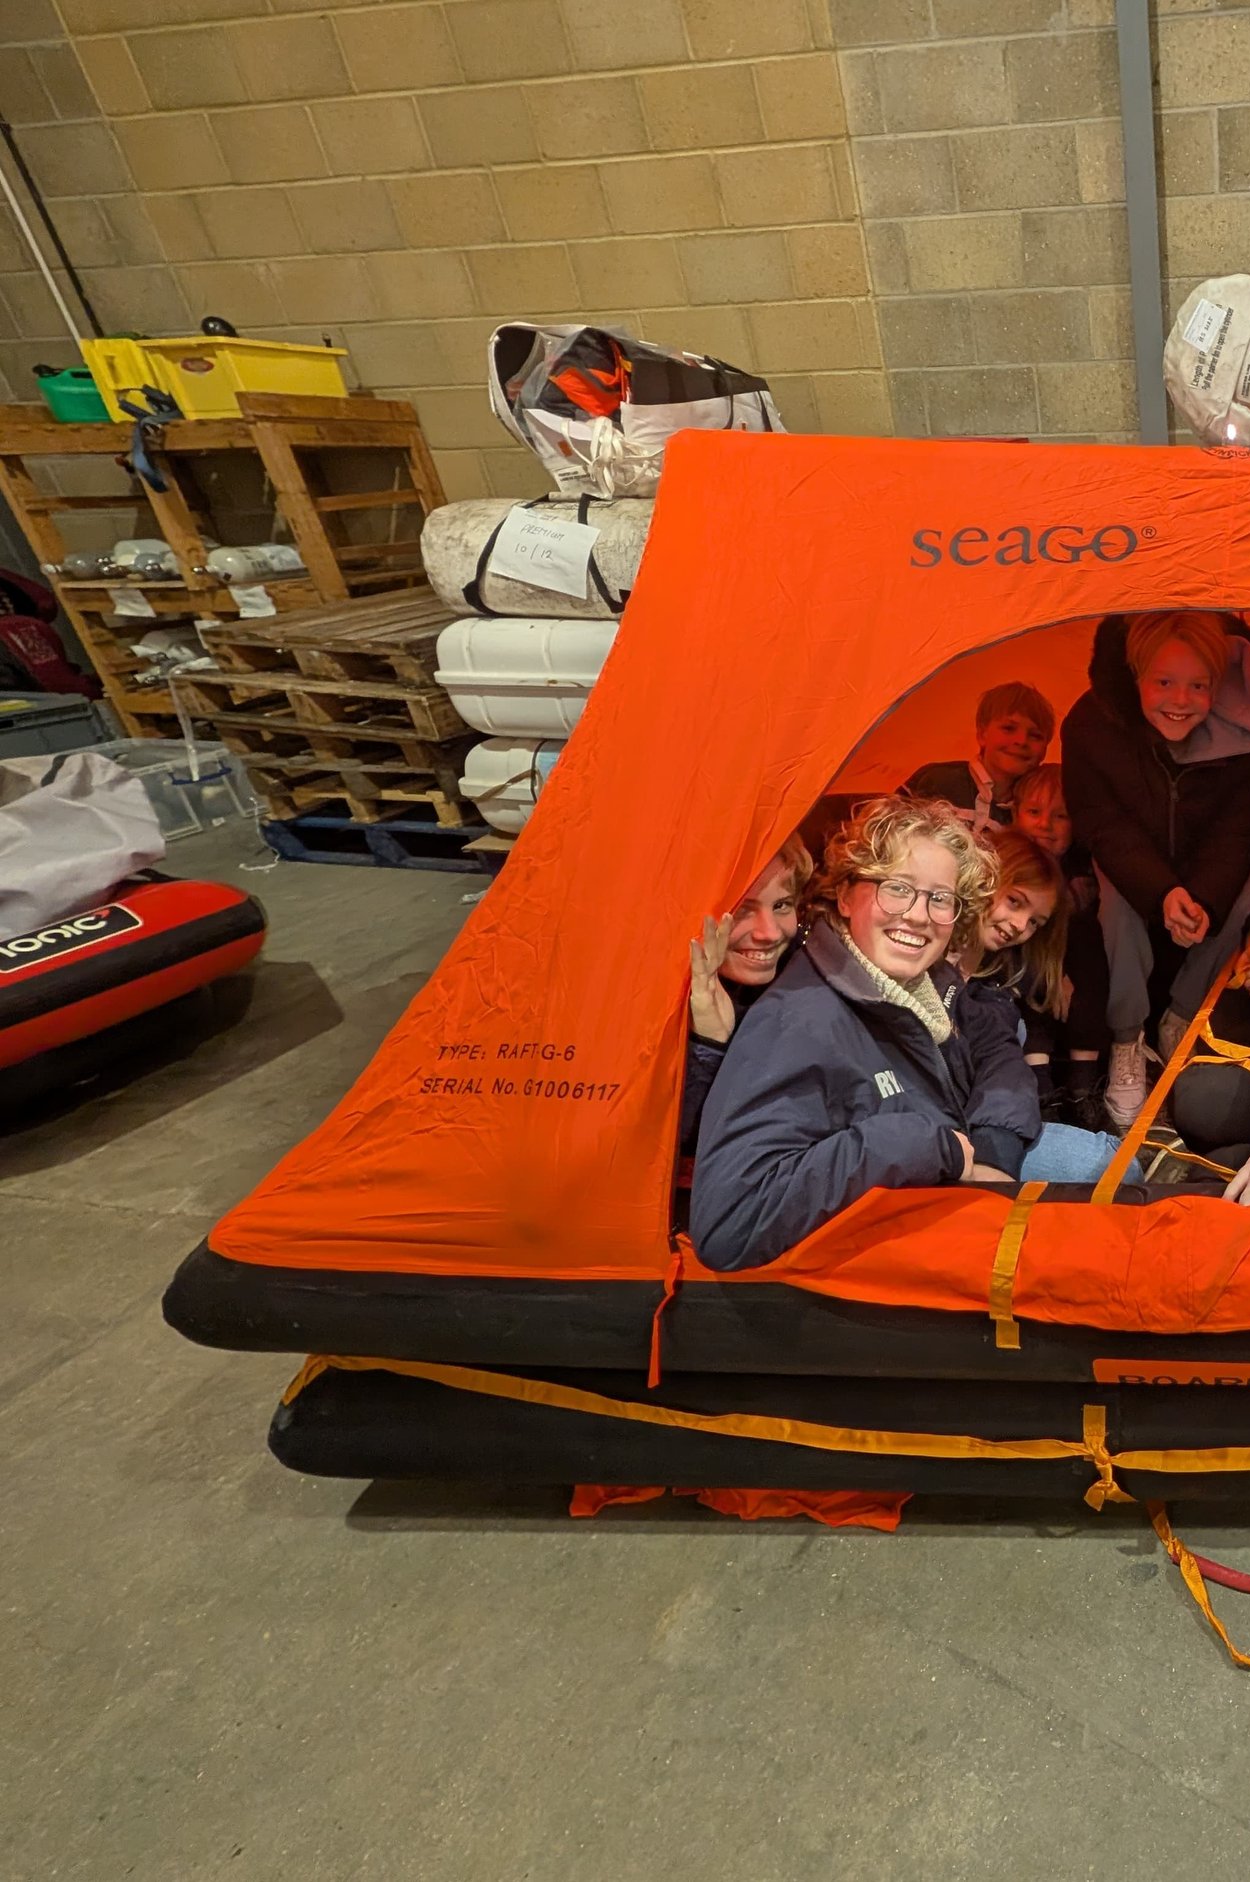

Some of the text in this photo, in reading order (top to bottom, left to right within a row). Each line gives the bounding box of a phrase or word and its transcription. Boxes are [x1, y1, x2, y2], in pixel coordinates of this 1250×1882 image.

[1191, 365, 1204, 387] Length
[437, 1044, 486, 1061] TYPE:
[420, 1077, 620, 1101] SERIAL No. G1006117
[874, 1070, 905, 1099] RY
